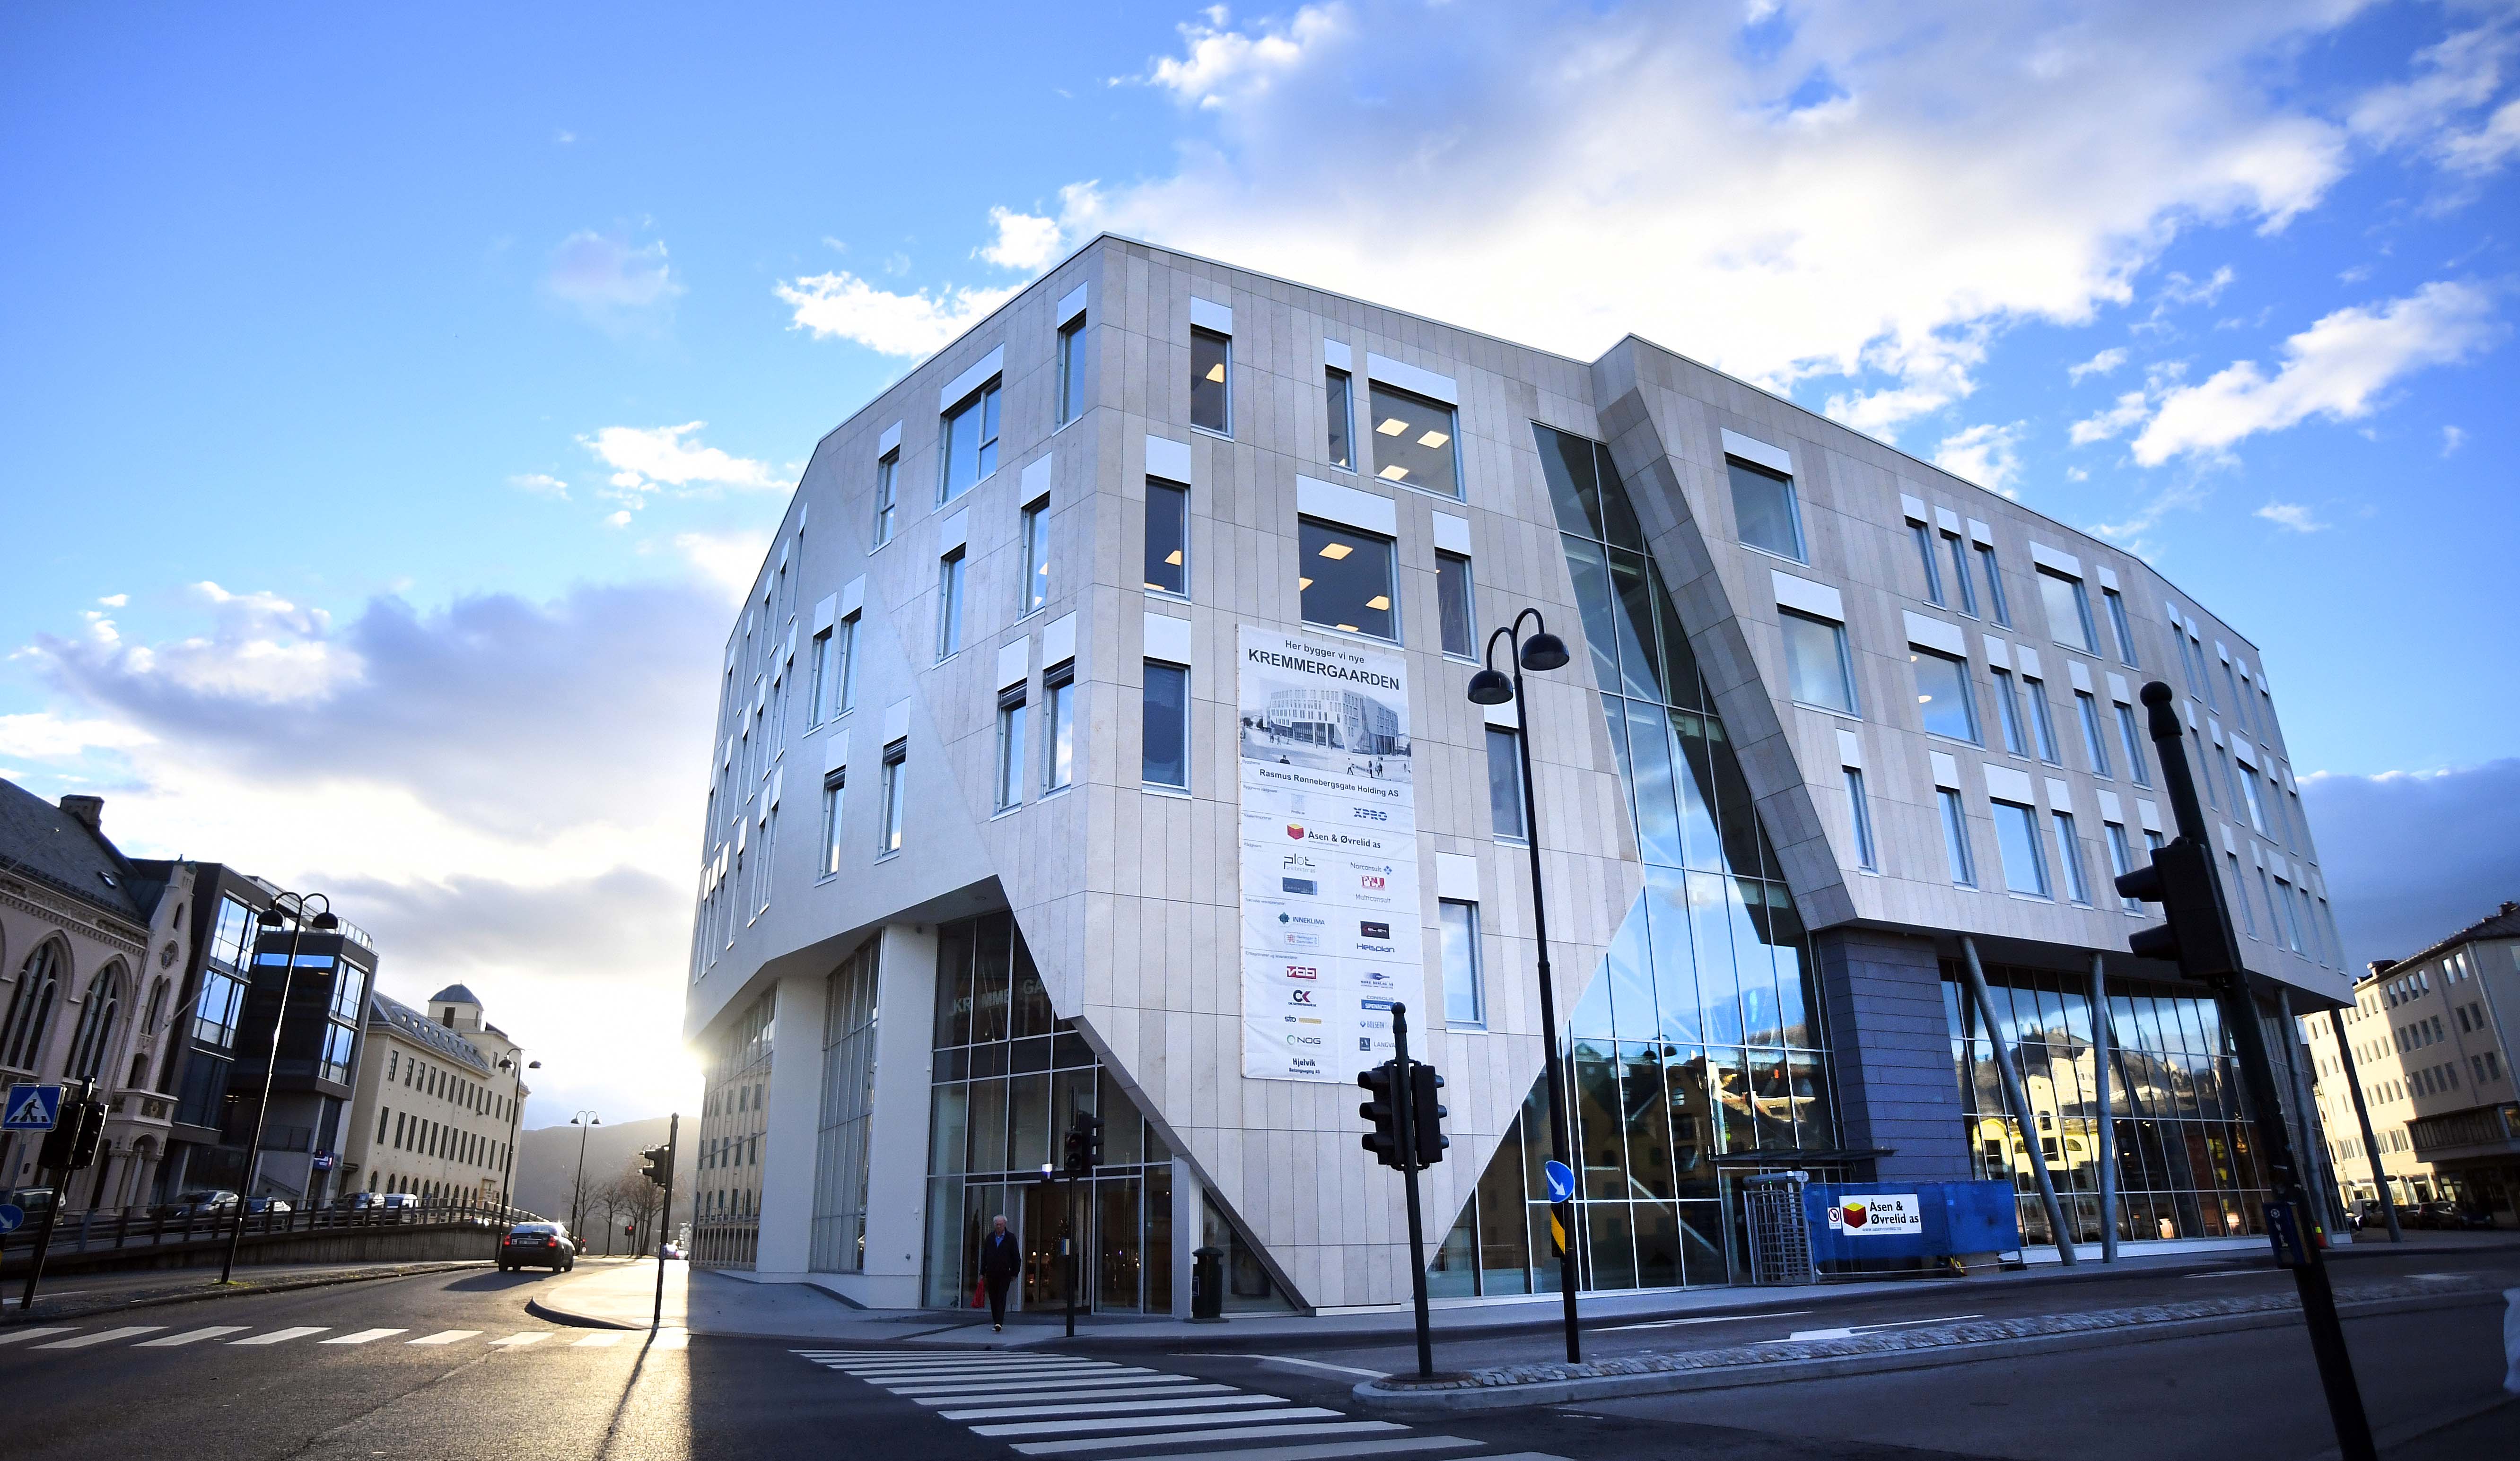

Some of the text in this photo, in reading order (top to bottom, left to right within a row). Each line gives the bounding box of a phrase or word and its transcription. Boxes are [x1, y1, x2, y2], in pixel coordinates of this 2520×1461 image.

[1285, 640, 1365, 663] Her bygger vi nye
[1248, 648, 1400, 690] KREMMERGAARDEN
[1260, 769, 1292, 781] Rasmus
[1294, 774, 1355, 791] Rønnebergsgate
[1357, 785, 1386, 797] Holding
[1353, 807, 1387, 821] XPRO
[1308, 828, 1329, 841] Åsen
[1331, 834, 1337, 842] &
[1340, 835, 1370, 847] Øvrelid
[1284, 853, 1315, 870] plot
[1350, 862, 1382, 872] Norconsult
[1355, 894, 1391, 904] Multiconsult
[1293, 916, 1325, 925] INNEKLIMA
[1356, 943, 1395, 953] Heisplan
[1297, 1036, 1321, 1044] NOG
[1293, 1058, 1315, 1067] Hjelvik
[1870, 1198, 1903, 1212] Åsen &
[1871, 1213, 1919, 1225] Øvrelid as
